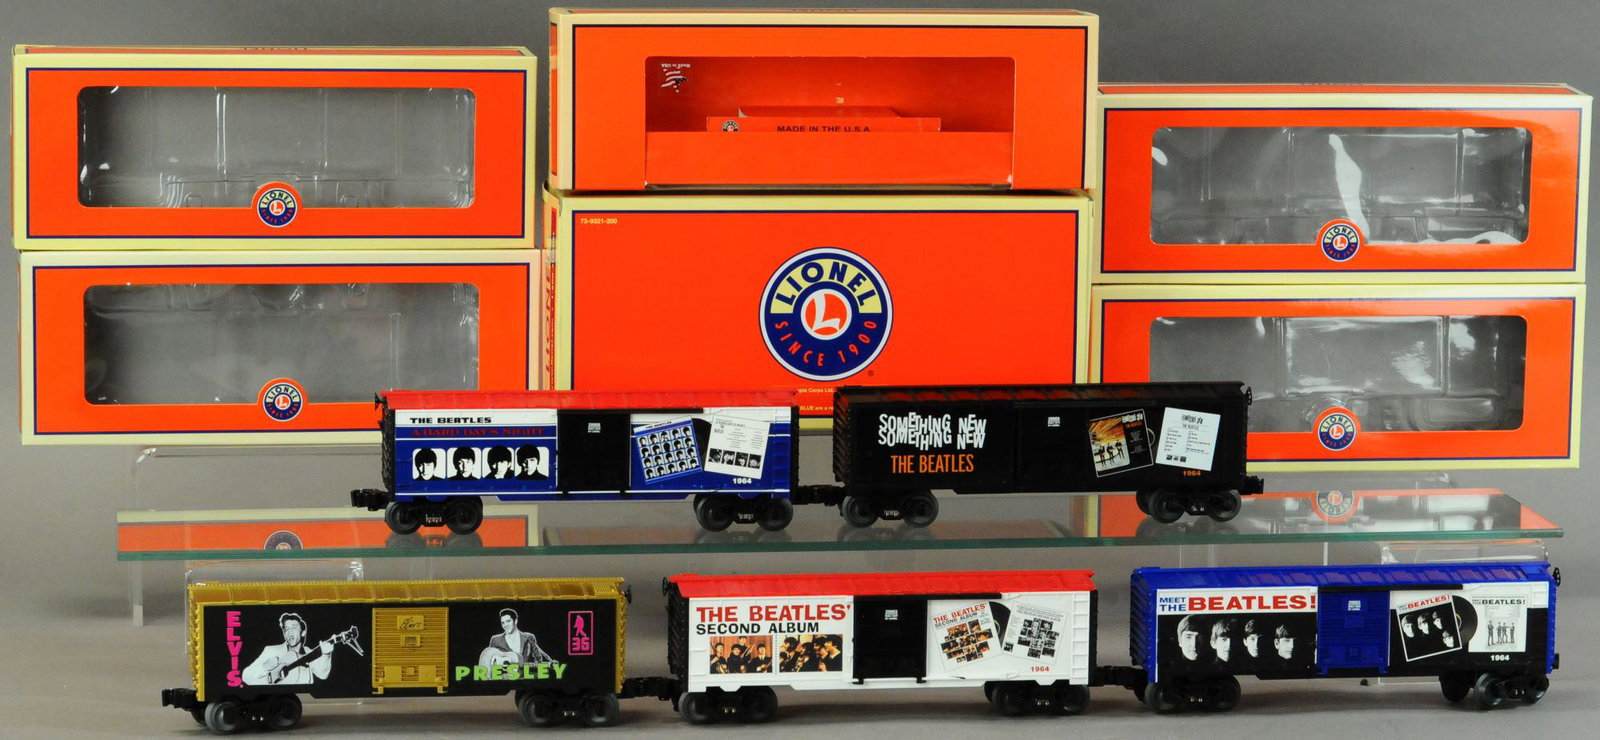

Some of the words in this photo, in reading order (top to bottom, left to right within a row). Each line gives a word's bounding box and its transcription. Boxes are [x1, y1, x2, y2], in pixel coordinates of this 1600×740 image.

[262, 192, 292, 205] LIONEL
[1326, 228, 1355, 240] LIONEL
[775, 261, 877, 306] LIONEL
[267, 387, 297, 400] LIONEL
[437, 416, 492, 424] BEATLES
[879, 412, 951, 434] SOMETHING
[958, 414, 987, 434] NEW
[878, 427, 952, 450] SOMETHING
[957, 432, 986, 450] NEW
[890, 455, 915, 474] THE
[919, 453, 975, 473] BEATLES
[1159, 604, 1186, 612] THE
[1188, 595, 1316, 612] BEATLES!
[1407, 595, 1450, 609] BEATLES!
[696, 606, 738, 623] THE
[749, 604, 850, 622] BEATLES'
[933, 615, 948, 624] THE
[696, 623, 761, 635] SECOND
[768, 622, 819, 634] ALBUM
[226, 611, 243, 688] ELVIS
[455, 663, 568, 681] PRESLEY
